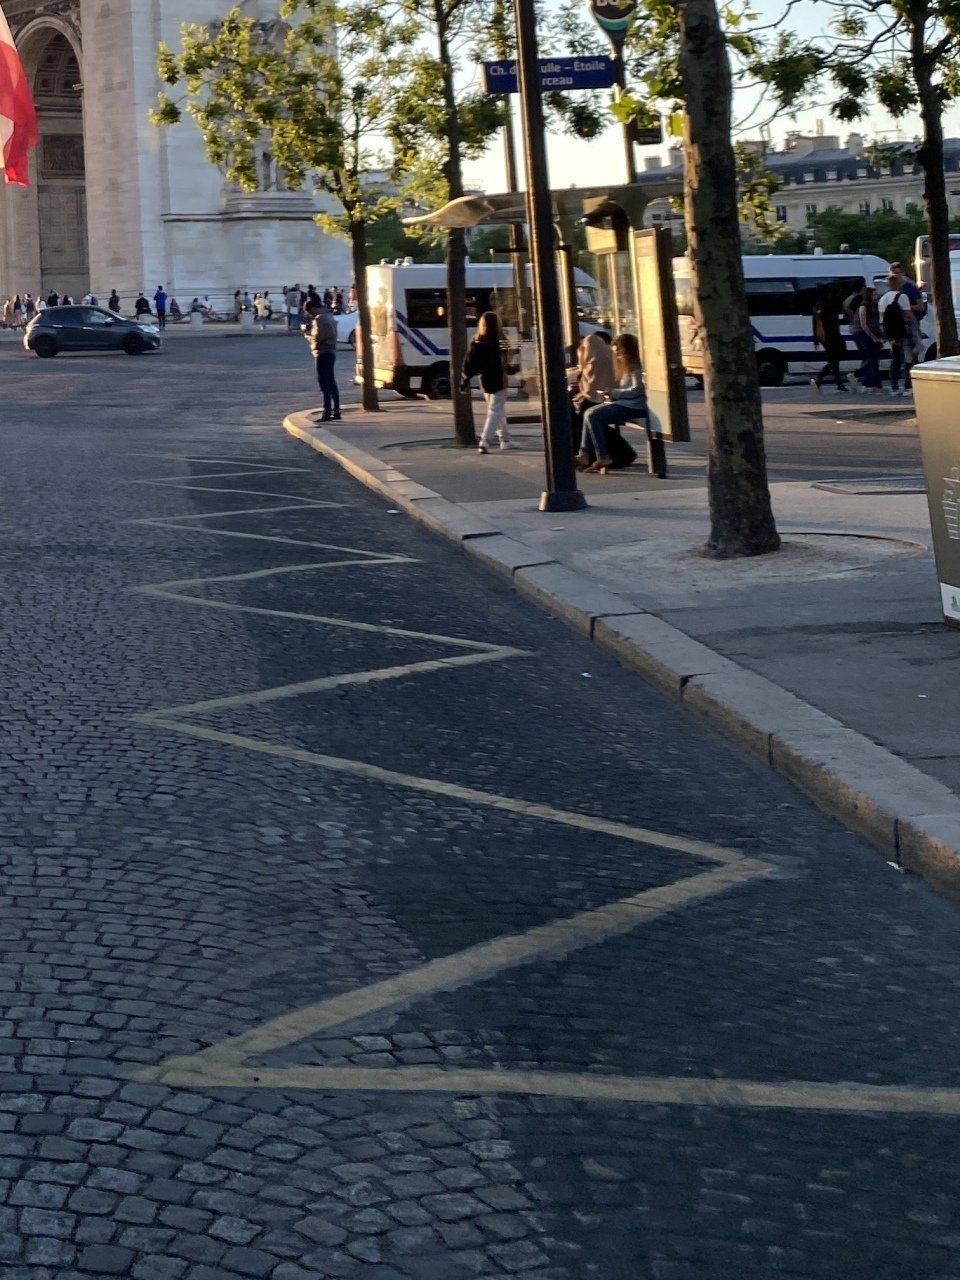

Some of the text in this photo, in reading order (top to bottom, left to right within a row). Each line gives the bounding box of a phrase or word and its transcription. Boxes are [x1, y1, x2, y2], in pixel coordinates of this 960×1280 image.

[489, 65, 508, 76] Ch.
[573, 60, 606, 72] Étoile
[542, 76, 573, 86] rceau
